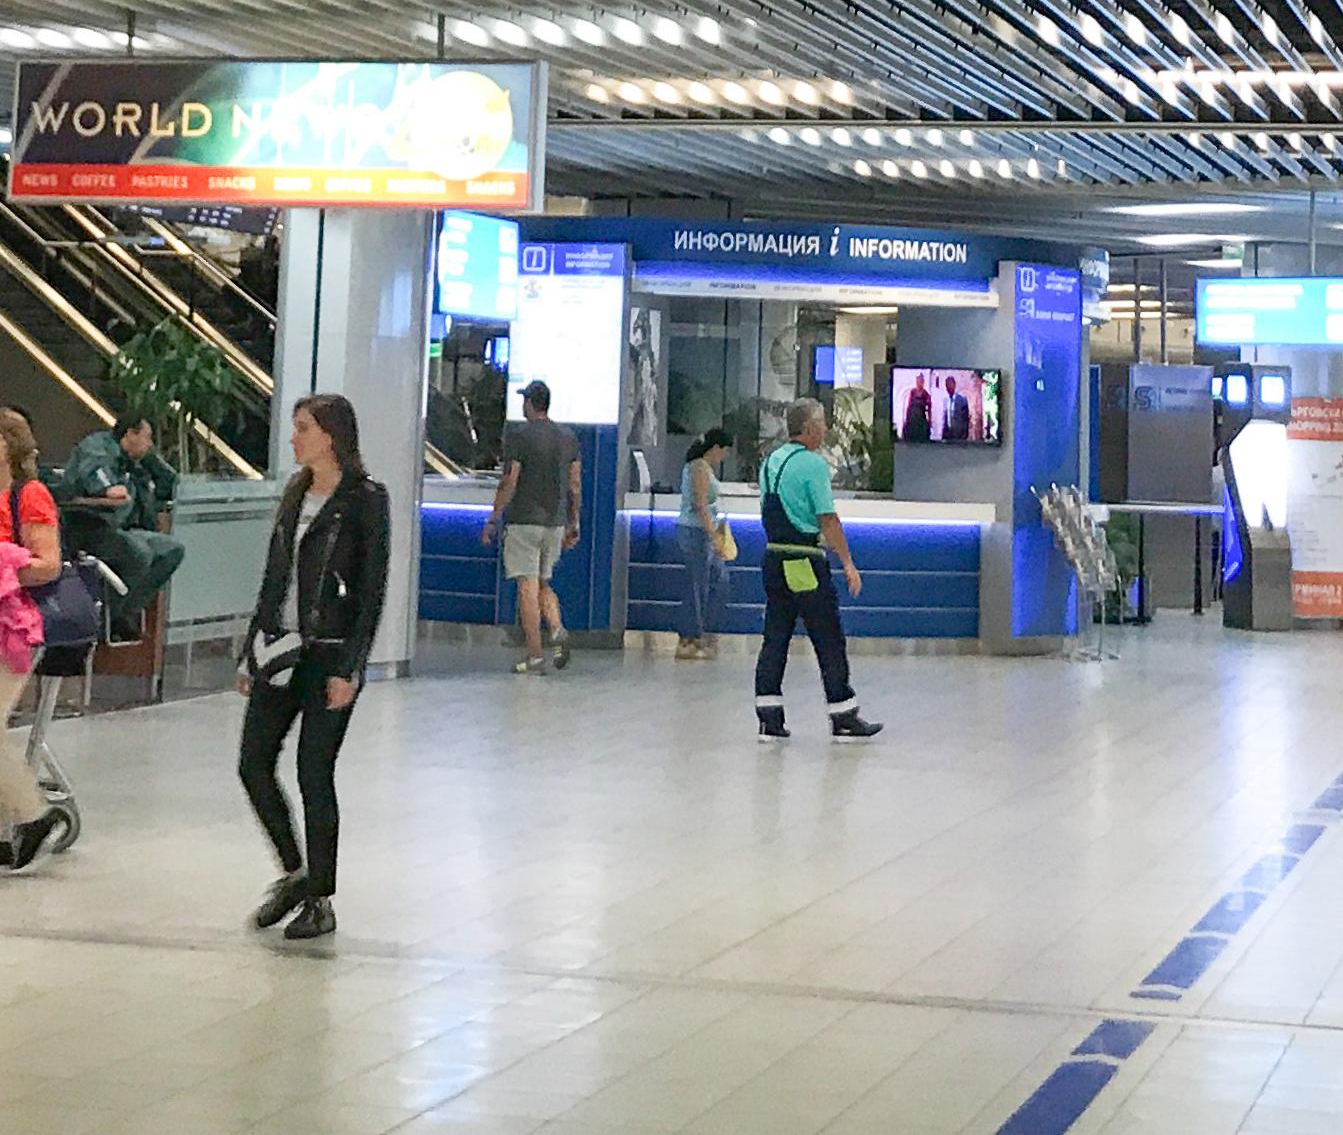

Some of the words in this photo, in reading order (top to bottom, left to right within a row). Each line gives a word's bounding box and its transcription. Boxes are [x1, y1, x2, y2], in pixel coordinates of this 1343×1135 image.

[31, 101, 214, 138] WORLD
[22, 174, 58, 187] NEWS
[131, 175, 189, 189] PASTRIES
[207, 176, 257, 191] SNACKS
[673, 230, 821, 258] ИНФОРМАЦИЯ
[849, 237, 968, 264] INFORMATION
